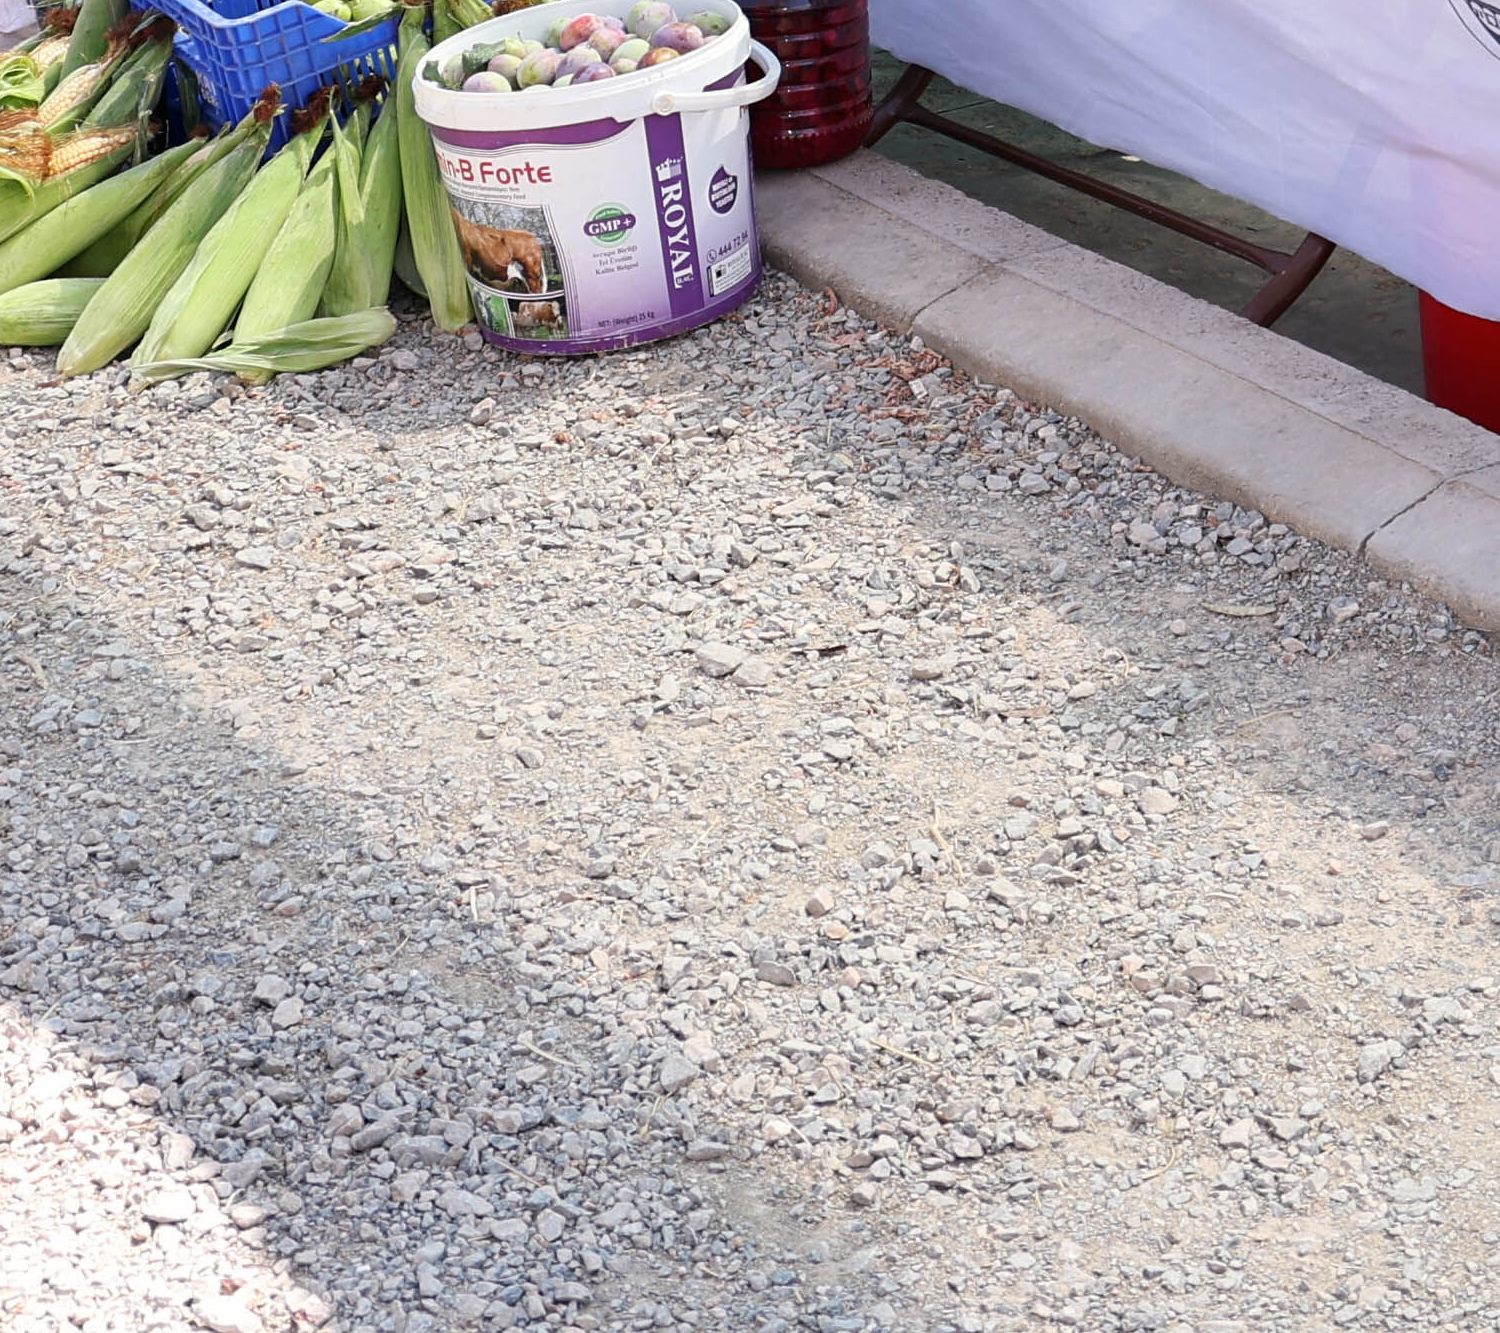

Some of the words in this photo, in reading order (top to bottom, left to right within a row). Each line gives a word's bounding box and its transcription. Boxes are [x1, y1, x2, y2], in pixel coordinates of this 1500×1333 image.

[479, 161, 553, 184] Forte
[588, 219, 621, 235] GMP
[661, 181, 694, 289] ROYAL
[717, 242, 732, 257] 444
